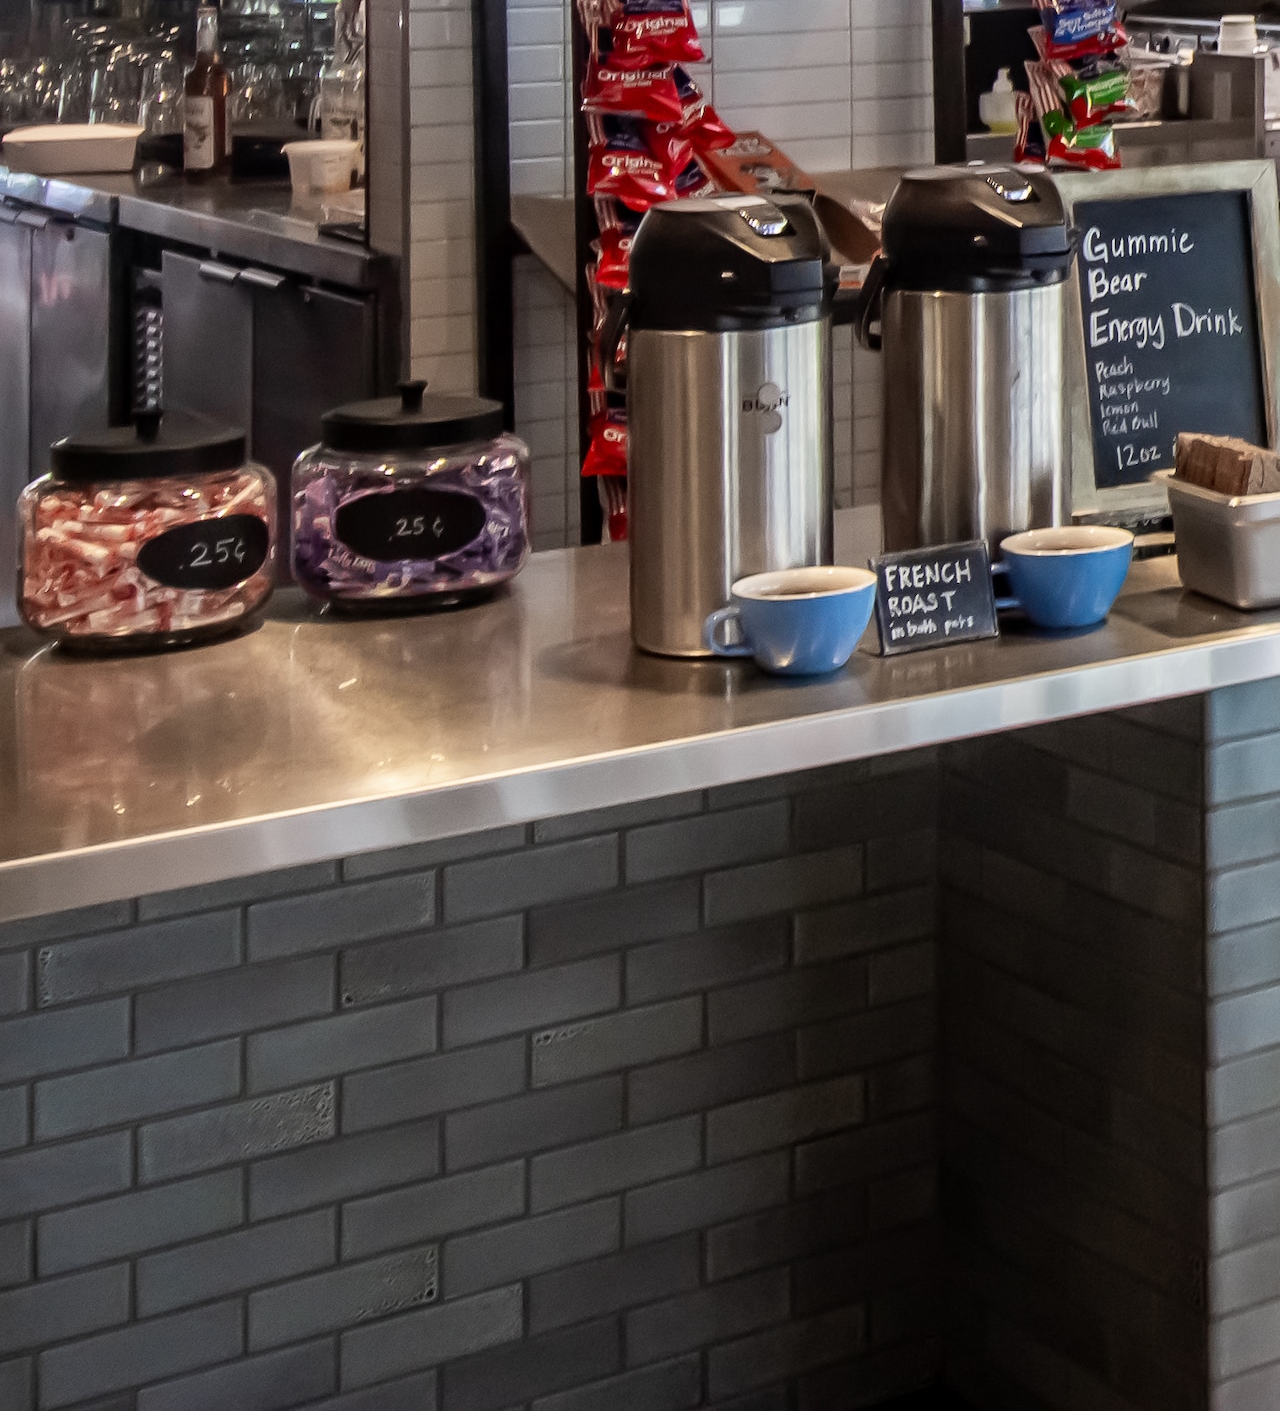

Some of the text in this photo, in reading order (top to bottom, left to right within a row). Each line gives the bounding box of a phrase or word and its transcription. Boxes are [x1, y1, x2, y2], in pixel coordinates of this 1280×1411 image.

[1083, 226, 1194, 264] Gummie
[1088, 267, 1148, 303] Bear
[1090, 302, 1243, 349] Energy Drink
[1096, 356, 1134, 383] Peach
[1099, 376, 1171, 401] Raspberry
[1102, 415, 1128, 437] Red
[885, 558, 972, 592] FRENCH
[888, 590, 957, 617] ROAST
[906, 618, 938, 637] both
